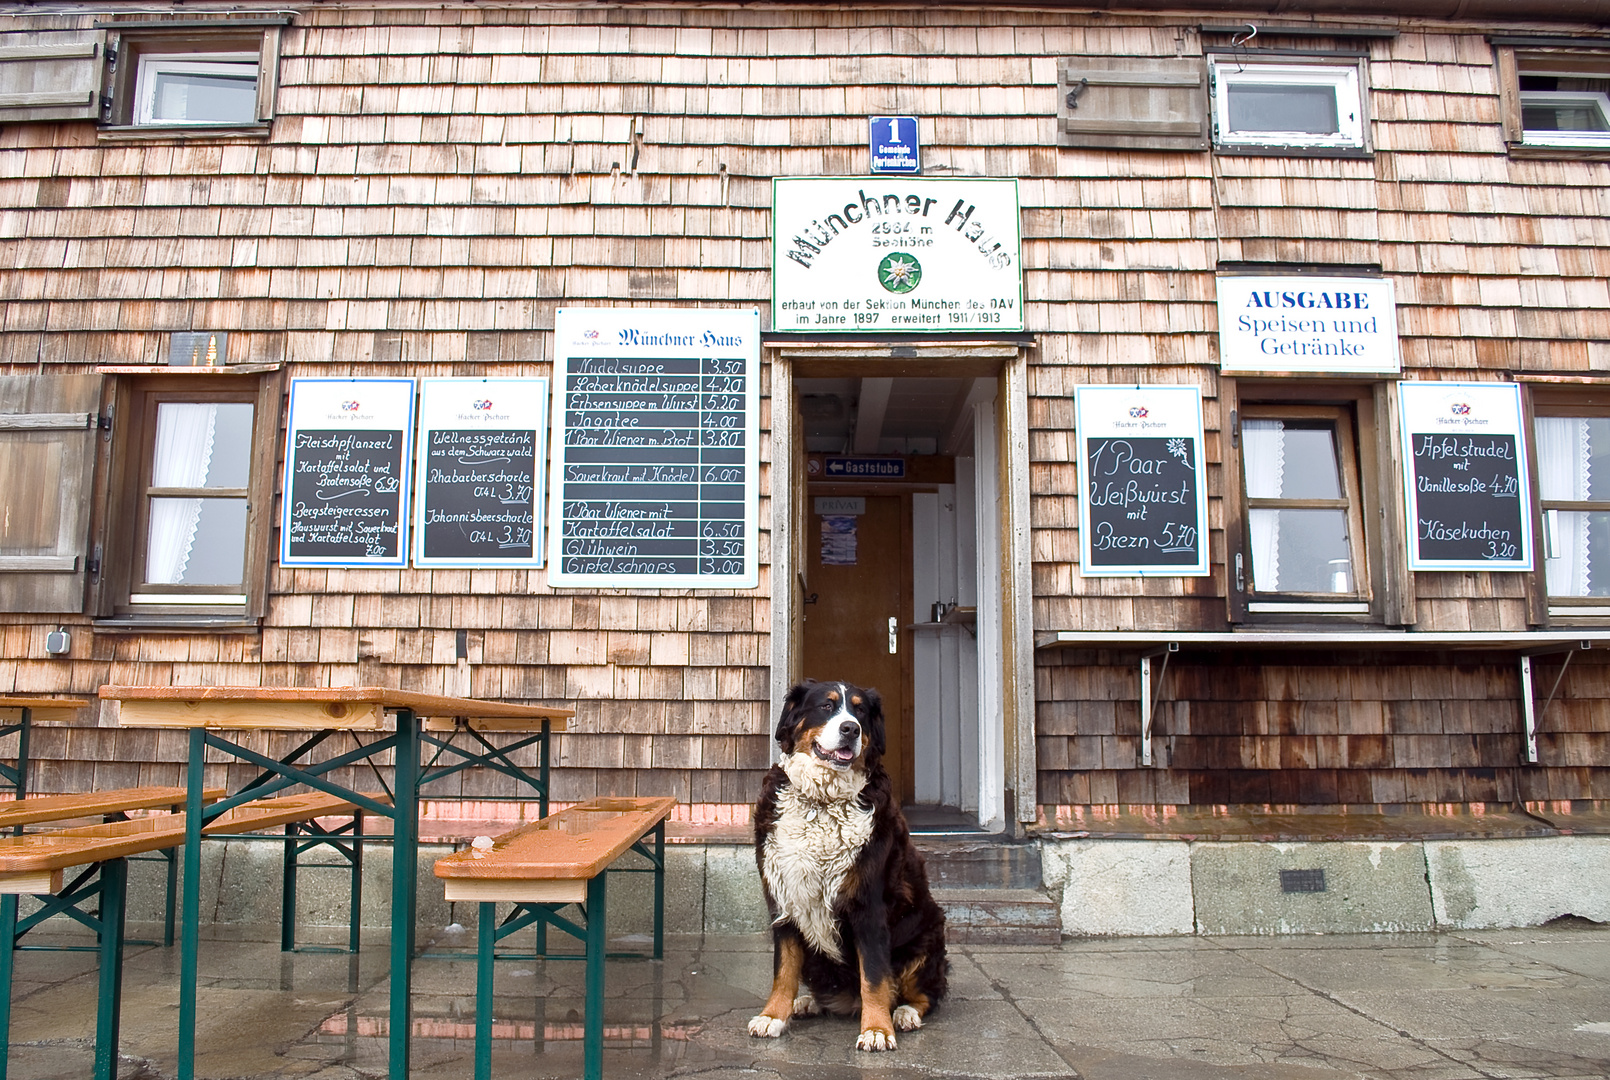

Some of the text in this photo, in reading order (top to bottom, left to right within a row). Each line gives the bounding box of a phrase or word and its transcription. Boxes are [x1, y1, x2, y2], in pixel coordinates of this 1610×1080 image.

[888, 119, 901, 143] 1
[879, 145, 911, 154] Gemeinde
[784, 190, 1011, 270] Münchner Haus
[872, 222, 914, 234] 2964
[782, 299, 1014, 310] erbaut von der Sektion München des DAV
[1246, 291, 1369, 309] AUSGABE
[796, 313, 1001, 324] im Jahre 1897 erweitert 1911/1913
[1238, 315, 1378, 337] Speisen und
[619, 328, 743, 348] Münchner Haus
[1260, 337, 1365, 356] Getränke
[576, 358, 743, 374] Nudelsuppe 3.50
[573, 376, 743, 392] Leberknödelsuppe 4.20
[570, 393, 647, 409] Erbsensuppe
[661, 394, 698, 409] Wurst
[705, 395, 740, 410] 5.20
[573, 411, 738, 427] Jagatee 4.00
[296, 433, 393, 451] Fleischpflanzerl
[433, 431, 530, 447] Wellnessgetränk
[565, 430, 573, 445] 1
[573, 429, 599, 445] Paar
[603, 429, 645, 445] Wiener
[660, 429, 694, 445] Brot
[702, 430, 741, 446] 3.80
[336, 452, 350, 460] mit
[431, 448, 446, 457] aus
[448, 446, 465, 457] dem
[1415, 436, 1514, 460] Apfelstrudel
[297, 460, 391, 474] Kartoffelsalat und
[1090, 440, 1168, 477] 1 Paar
[1453, 459, 1471, 471] mit
[427, 468, 530, 483] Rhabarberschorle
[566, 466, 742, 482] Sauerkraut mit Knödel 6.00
[845, 461, 900, 474] Gaststube
[316, 474, 399, 493] Bratensoße 6.90
[1418, 474, 1518, 497] Vanillesoße 4.70
[499, 483, 532, 504] 3.70
[293, 501, 389, 519] Bergsteigeressen
[564, 501, 673, 519] 1 Paar Wiener mit
[822, 501, 858, 510] PRIVAT
[1127, 505, 1148, 520] mit
[425, 508, 533, 525] Johannisbeerschorle
[291, 521, 338, 534] Hauswurst
[340, 521, 353, 532] mit
[563, 521, 741, 538] Kartoffelsalat 6.50
[1418, 518, 1511, 541] Käsekuchen
[308, 533, 381, 545] Kartoffelsalat
[496, 525, 532, 548] 3.70
[1093, 521, 1198, 553] Brezn 5.70
[366, 545, 386, 557] 7.00
[567, 539, 743, 556] Glühwein 3.50
[1481, 542, 1517, 560] 3.20
[567, 557, 742, 574] Gipfelschnaps 3.00
